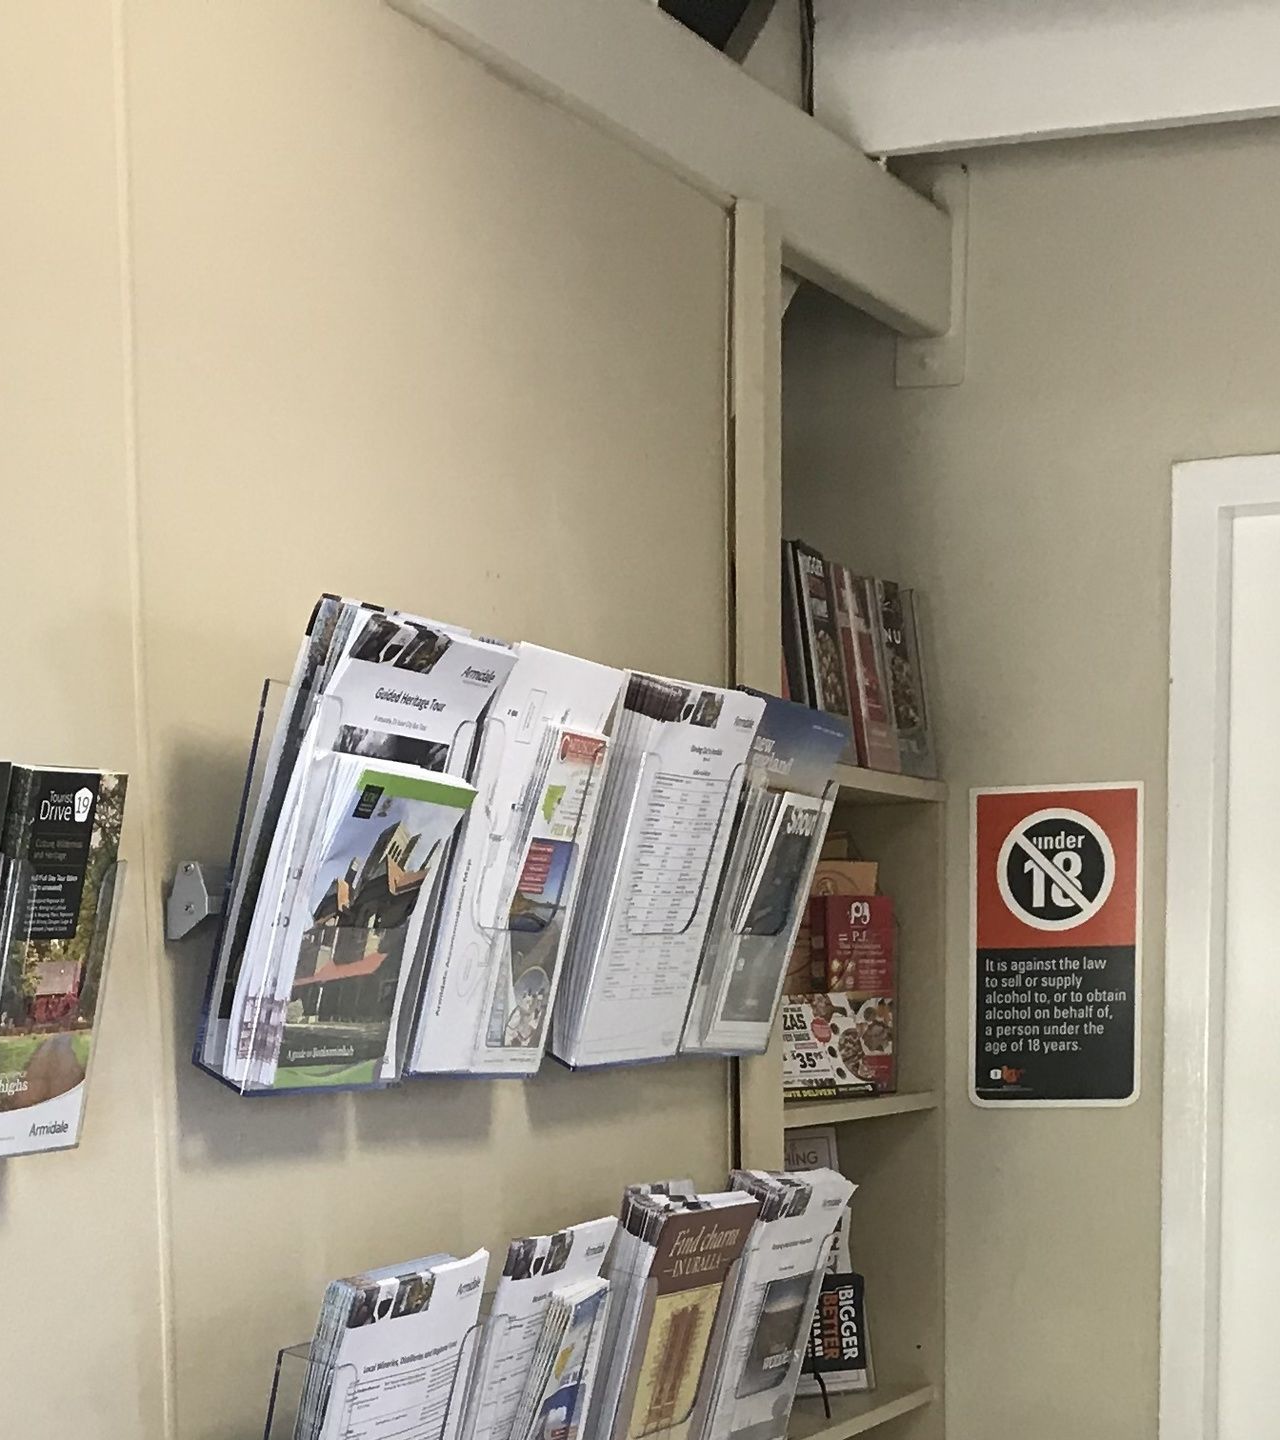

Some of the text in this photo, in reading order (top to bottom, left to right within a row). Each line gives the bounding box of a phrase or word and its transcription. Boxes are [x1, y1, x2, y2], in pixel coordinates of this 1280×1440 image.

[375, 687, 446, 713] Guided Heritage Tour
[50, 790, 73, 804] Tourist
[40, 796, 89, 821] Drive 19
[1032, 832, 1085, 850] under
[1023, 851, 1083, 908] 18
[986, 956, 1107, 973] It is against the law
[985, 973, 1083, 989] to sell or supply
[985, 988, 1127, 1004] alcohol to, or to obtain
[985, 1005, 1113, 1020] alcohol on behalf of,
[985, 1022, 1104, 1038] a person under the
[985, 1038, 1082, 1055] age of 18 years.
[29, 1120, 69, 1137] Armidale
[669, 1224, 740, 1257] Find charm
[673, 1254, 721, 1278] IN URALLA
[823, 1293, 841, 1360] BETTER
[838, 1288, 858, 1360] BIGGER
